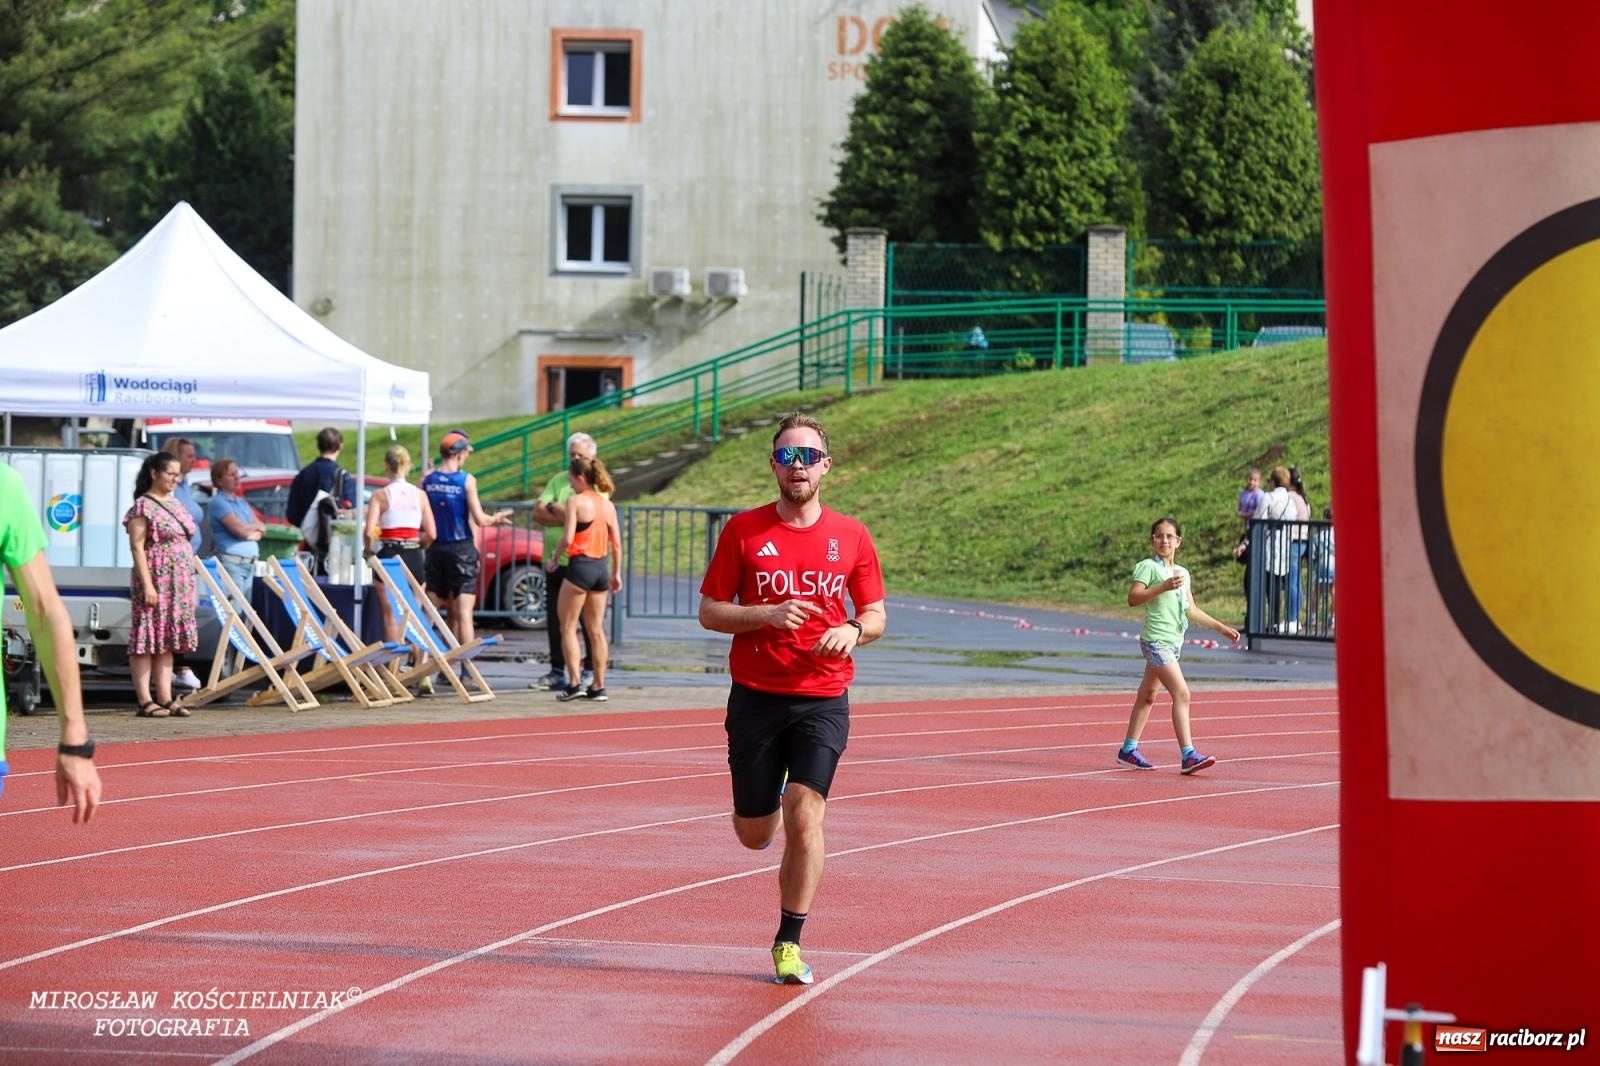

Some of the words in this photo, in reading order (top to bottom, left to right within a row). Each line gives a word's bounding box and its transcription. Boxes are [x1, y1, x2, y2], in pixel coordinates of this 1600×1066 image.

[837, 15, 899, 56] DO
[827, 62, 868, 81] SPO
[113, 378, 198, 394] Wodociągi
[756, 569, 846, 600] POLSKA
